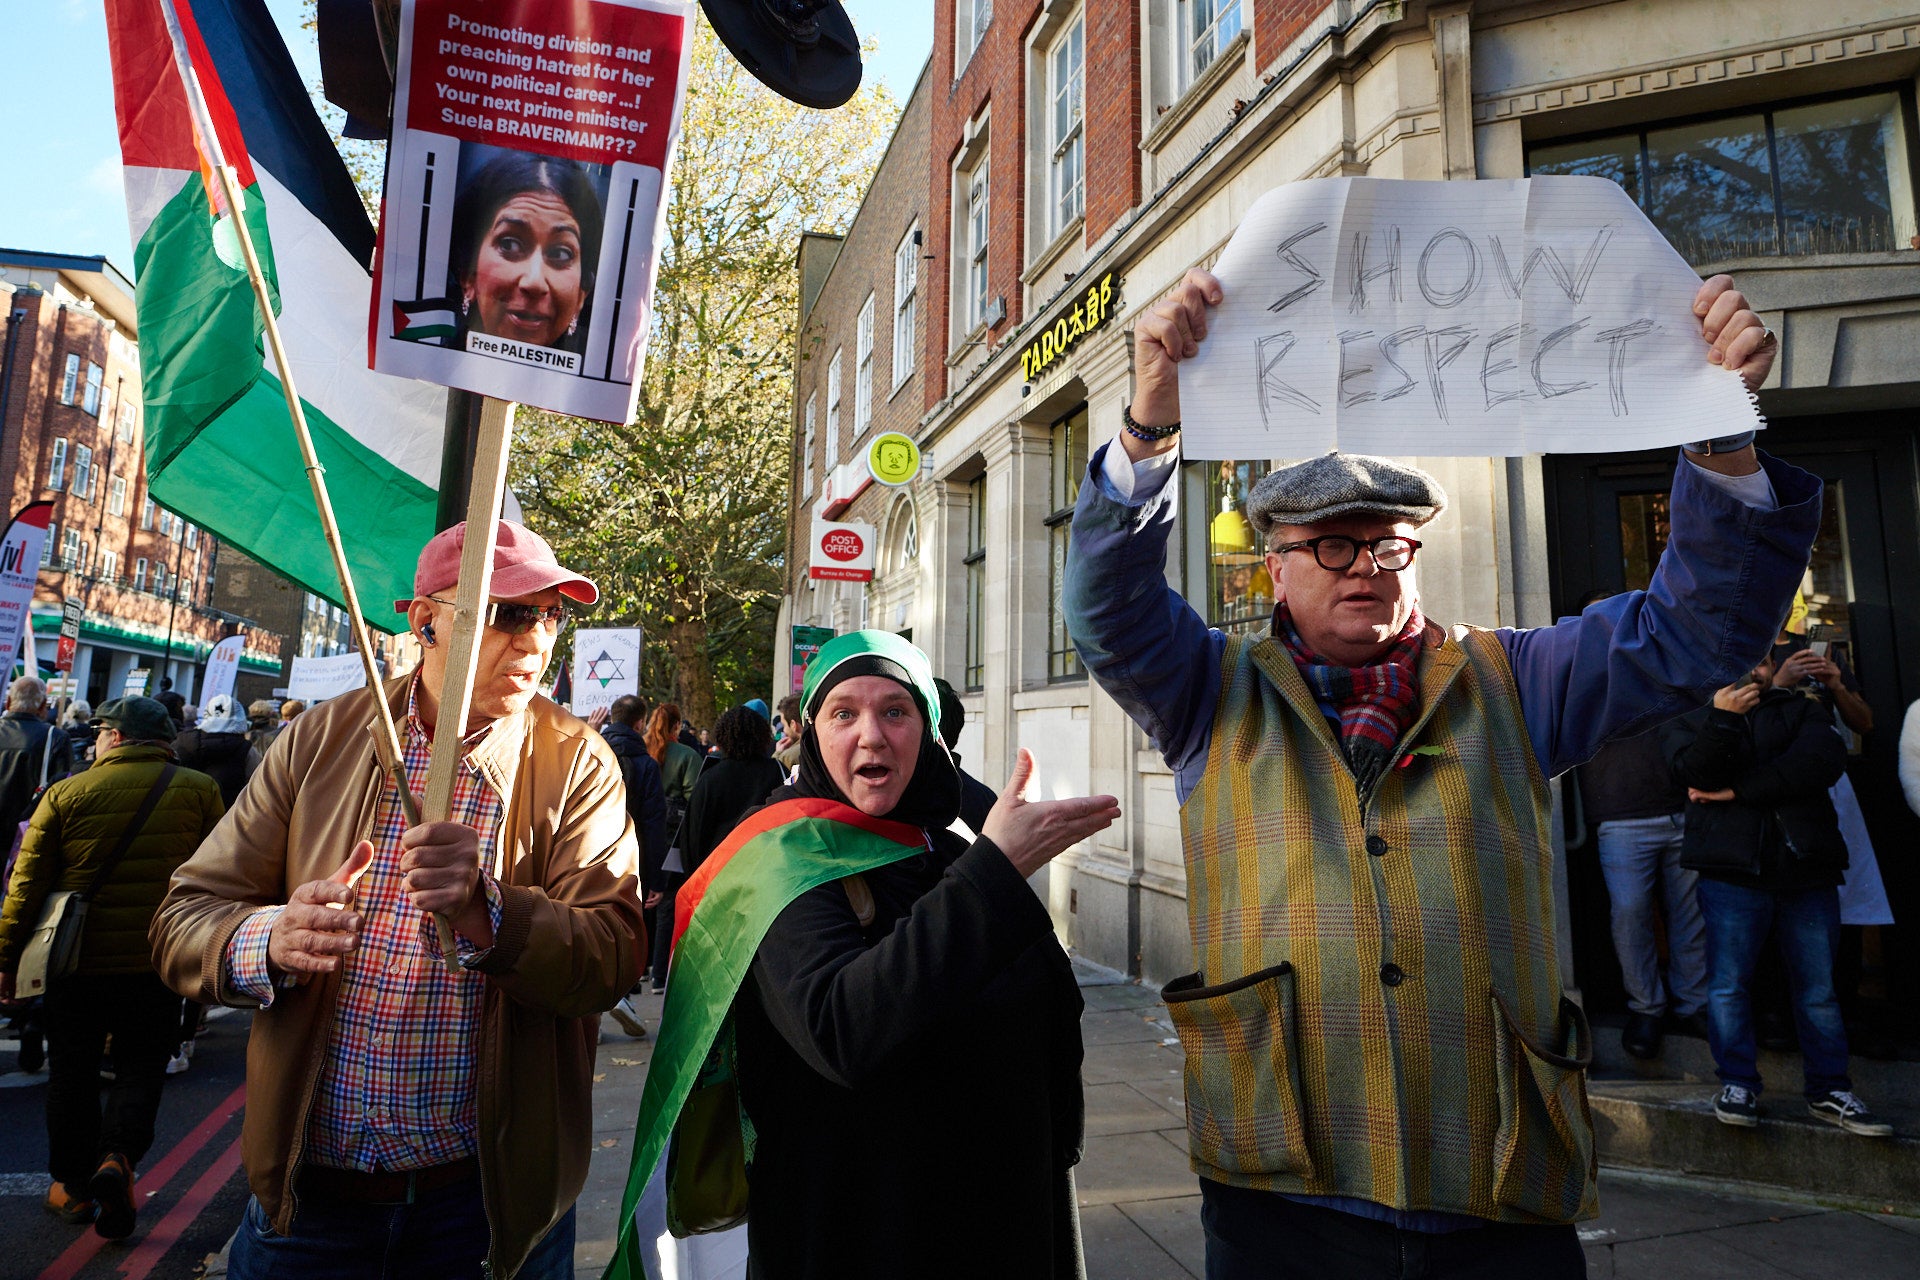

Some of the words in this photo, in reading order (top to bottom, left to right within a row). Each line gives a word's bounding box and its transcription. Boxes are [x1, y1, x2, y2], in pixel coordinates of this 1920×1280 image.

[448, 13, 545, 50] Promoting
[548, 34, 612, 56] division
[615, 46, 651, 64] and
[438, 39, 532, 71] preaching
[535, 55, 590, 78] hatred
[593, 64, 619, 81] for
[622, 68, 654, 88] her
[447, 64, 487, 84] own
[491, 73, 560, 97] political
[564, 86, 616, 105] career
[435, 82, 480, 104] Your
[482, 94, 520, 114] next
[523, 101, 573, 121] prime
[576, 109, 648, 134] minister
[441, 107, 492, 131] Suela
[1267, 220, 1622, 313] SHOW
[472, 336, 498, 352] Free
[501, 343, 574, 369] PALESTINE
[1255, 316, 1658, 431] RESPECT
[0, 540, 27, 574] jvl
[825, 544, 859, 554] OFFICE
[831, 536, 855, 545] POST
[578, 694, 622, 706] GENOC
